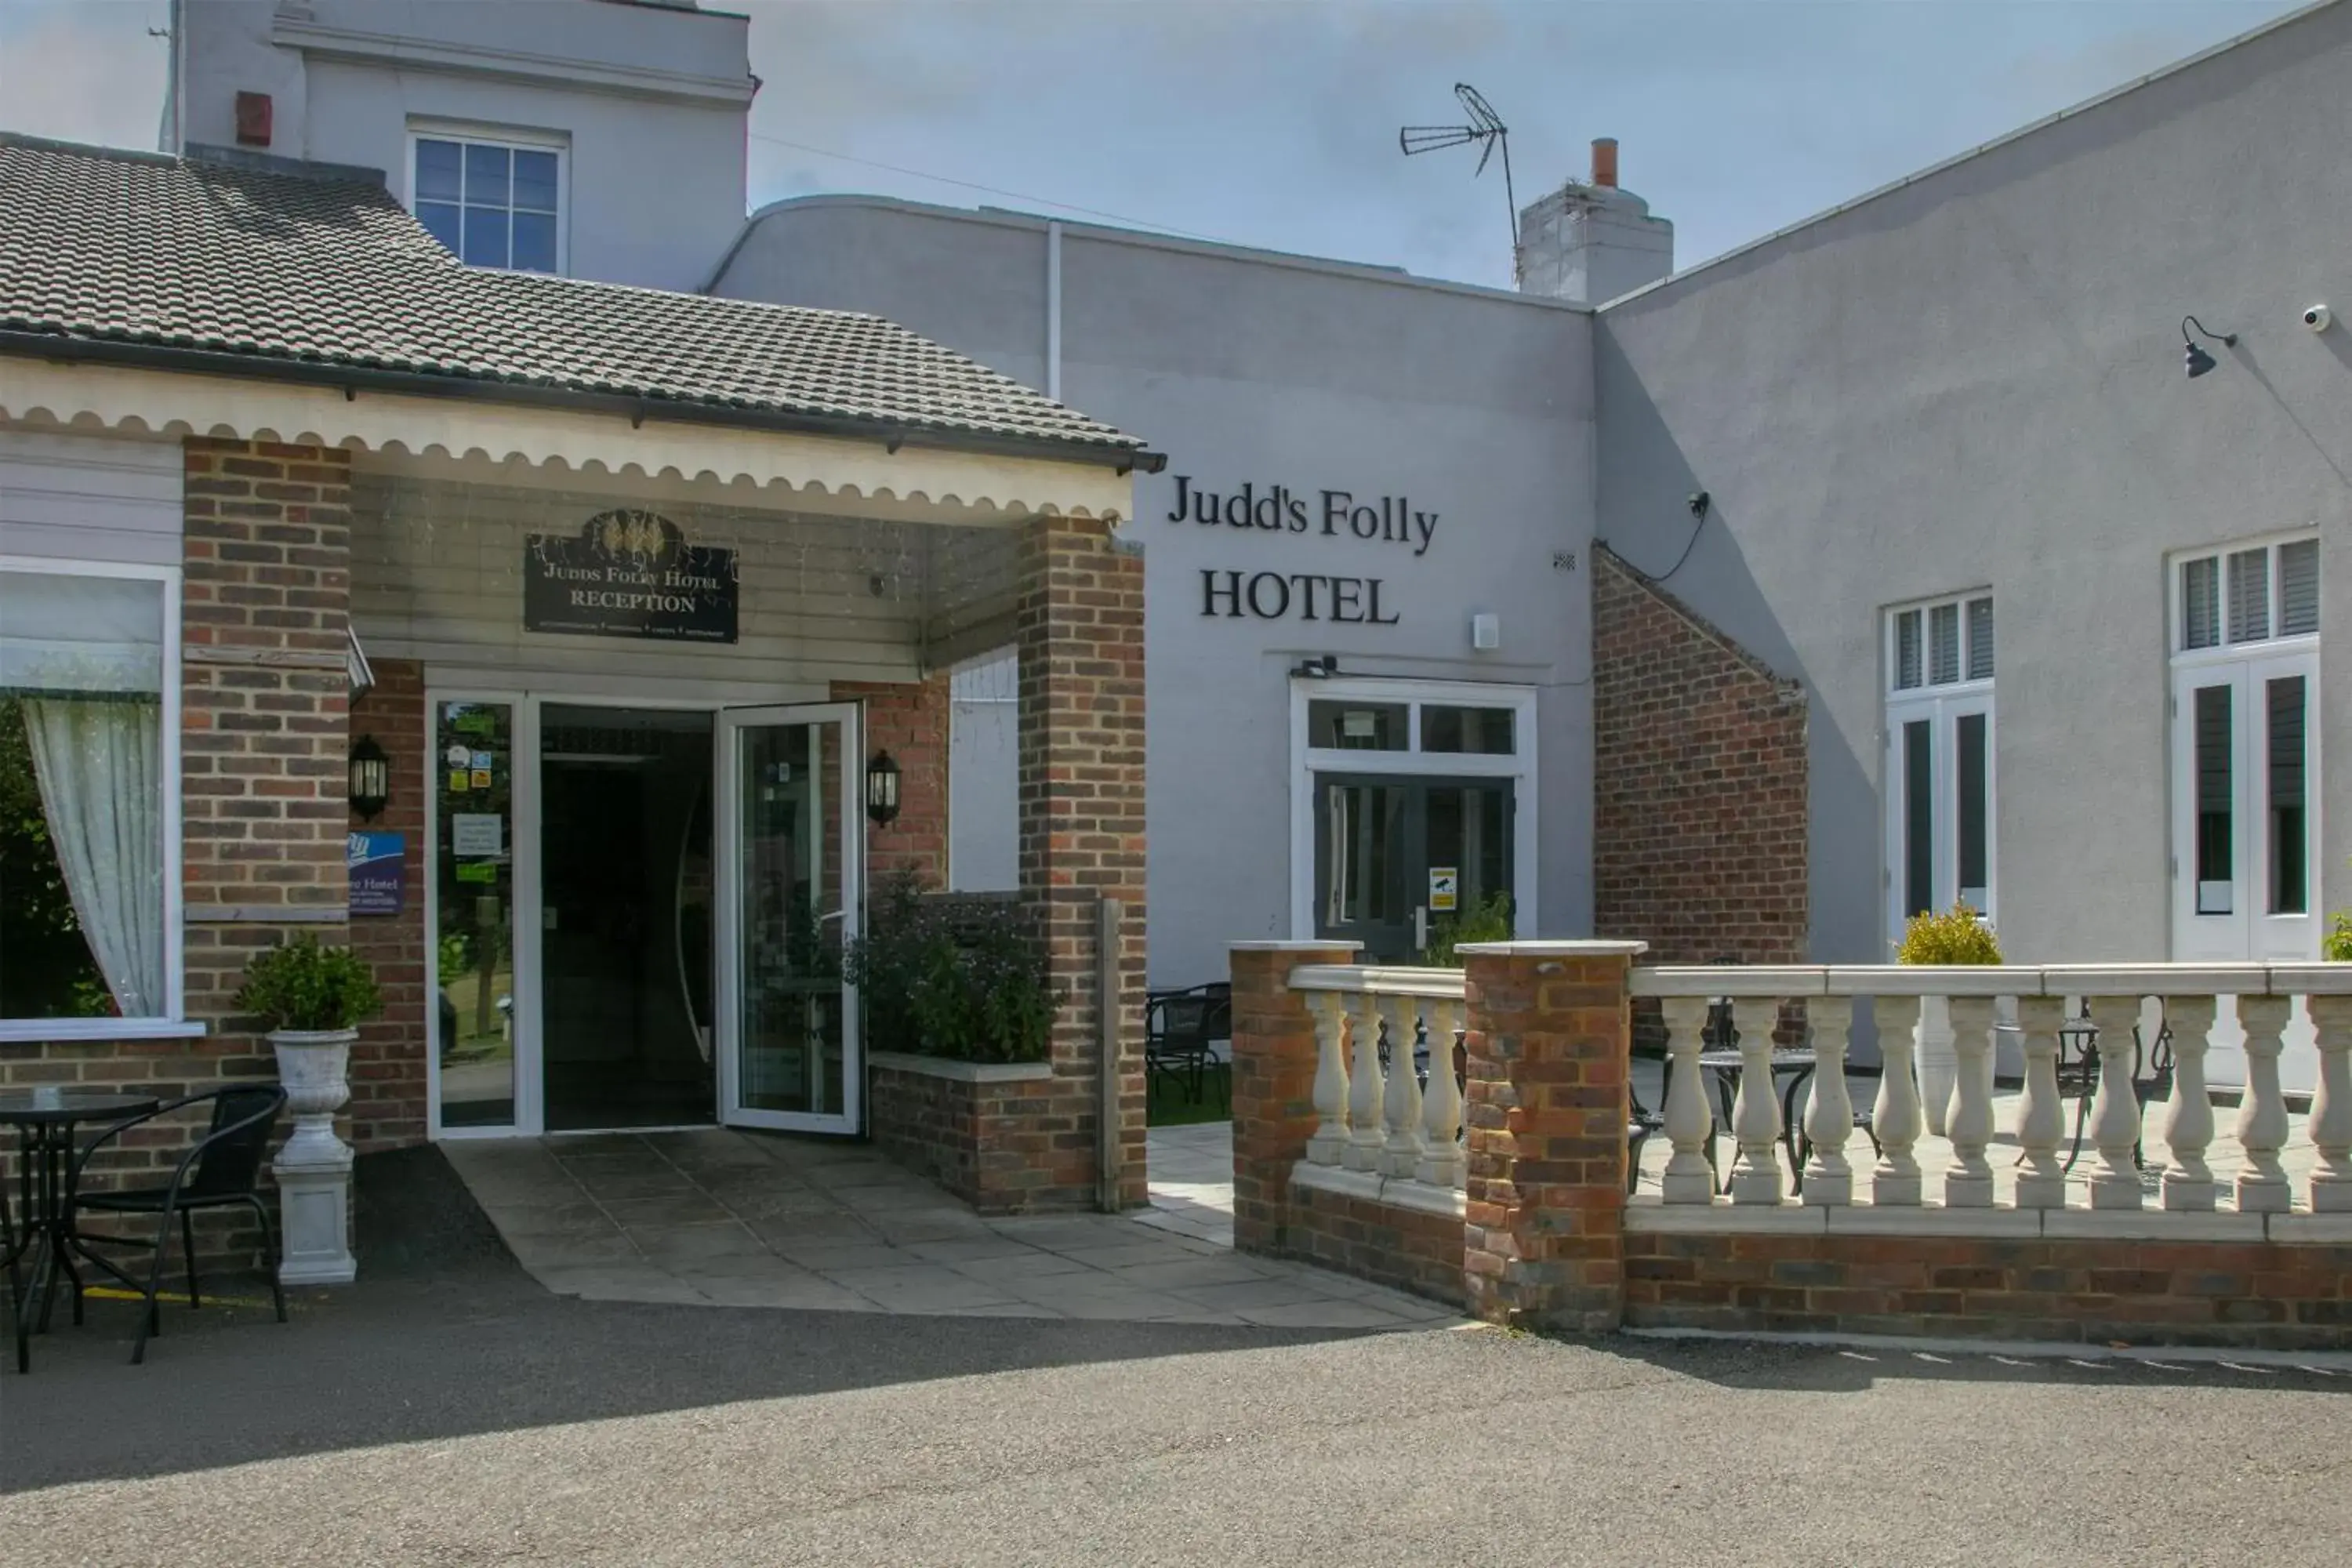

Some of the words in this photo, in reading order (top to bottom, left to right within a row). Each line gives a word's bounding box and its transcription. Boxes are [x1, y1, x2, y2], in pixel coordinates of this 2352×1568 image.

[1167, 474, 1308, 534] Judd's
[1319, 489, 1439, 557] Folly
[570, 589, 697, 614] RECEPTION
[1200, 569, 1401, 626] HOTEL
